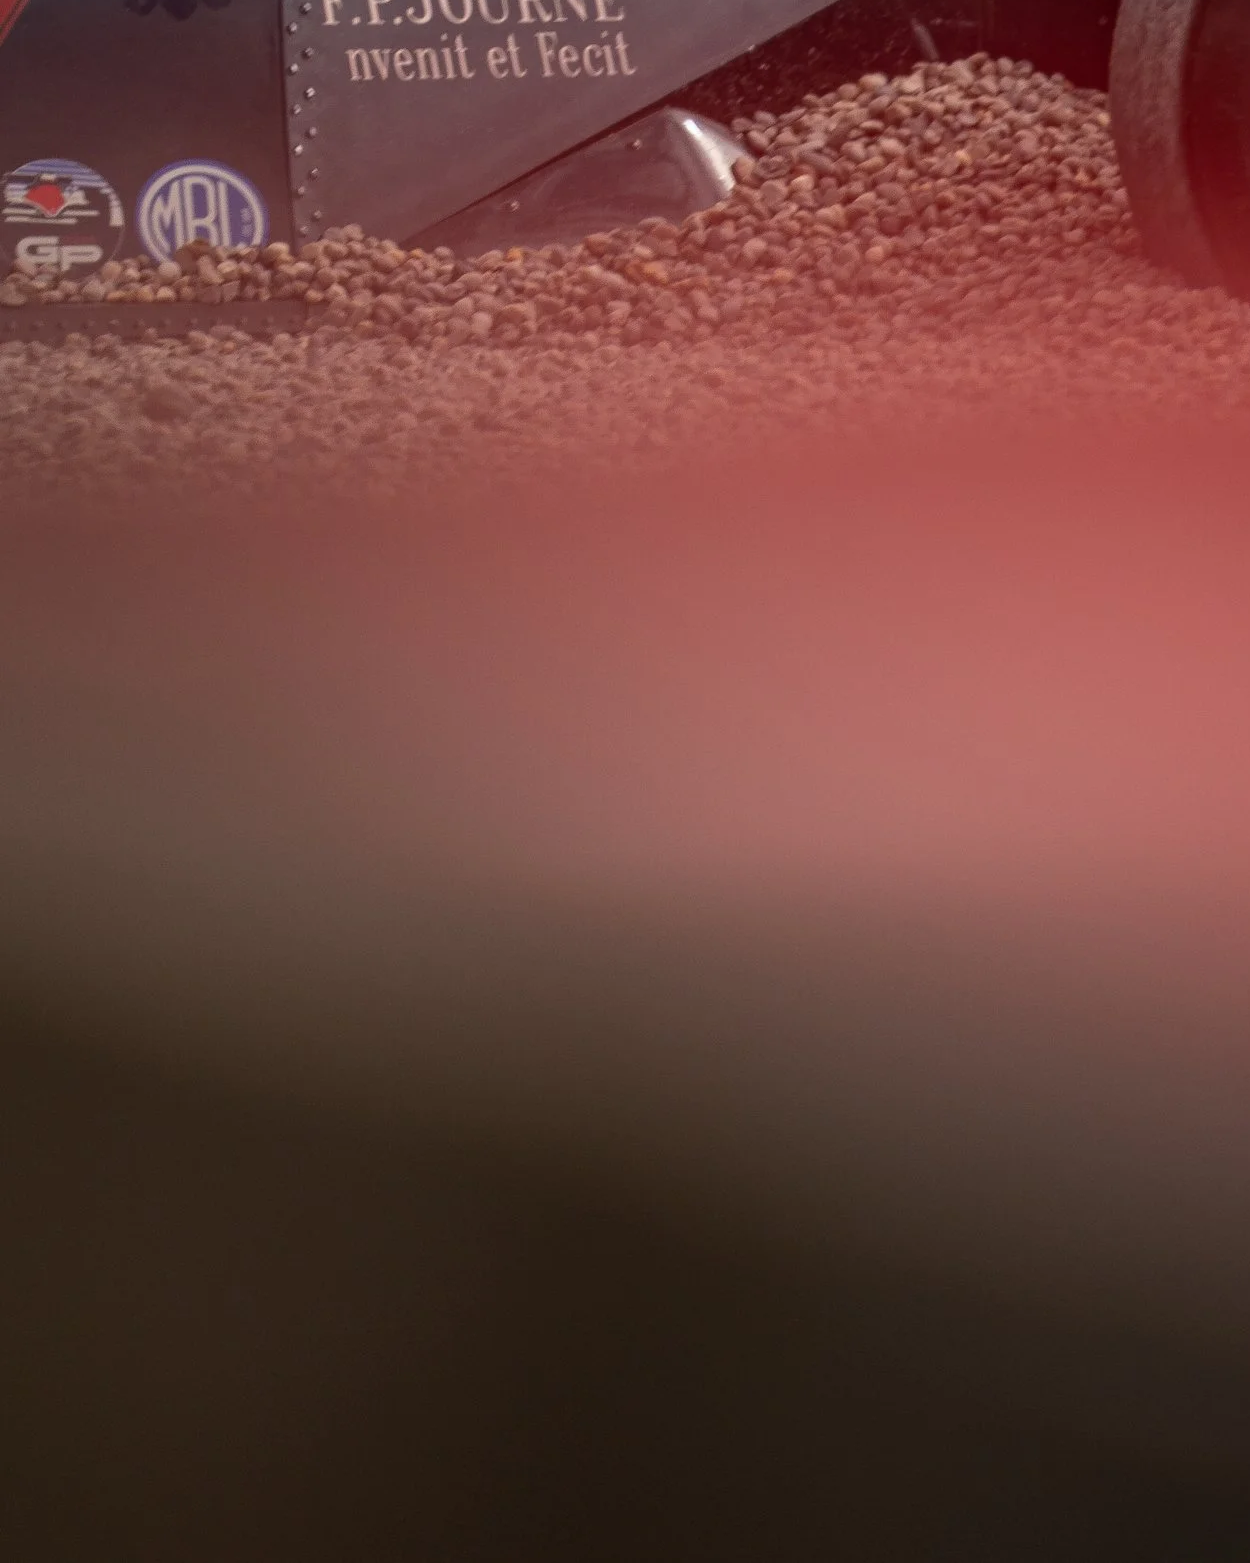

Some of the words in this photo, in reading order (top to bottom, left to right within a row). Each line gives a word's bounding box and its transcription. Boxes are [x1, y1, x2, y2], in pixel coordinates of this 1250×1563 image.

[486, 35, 527, 79] et
[535, 30, 638, 78] Fecit
[15, 236, 103, 272] GP
